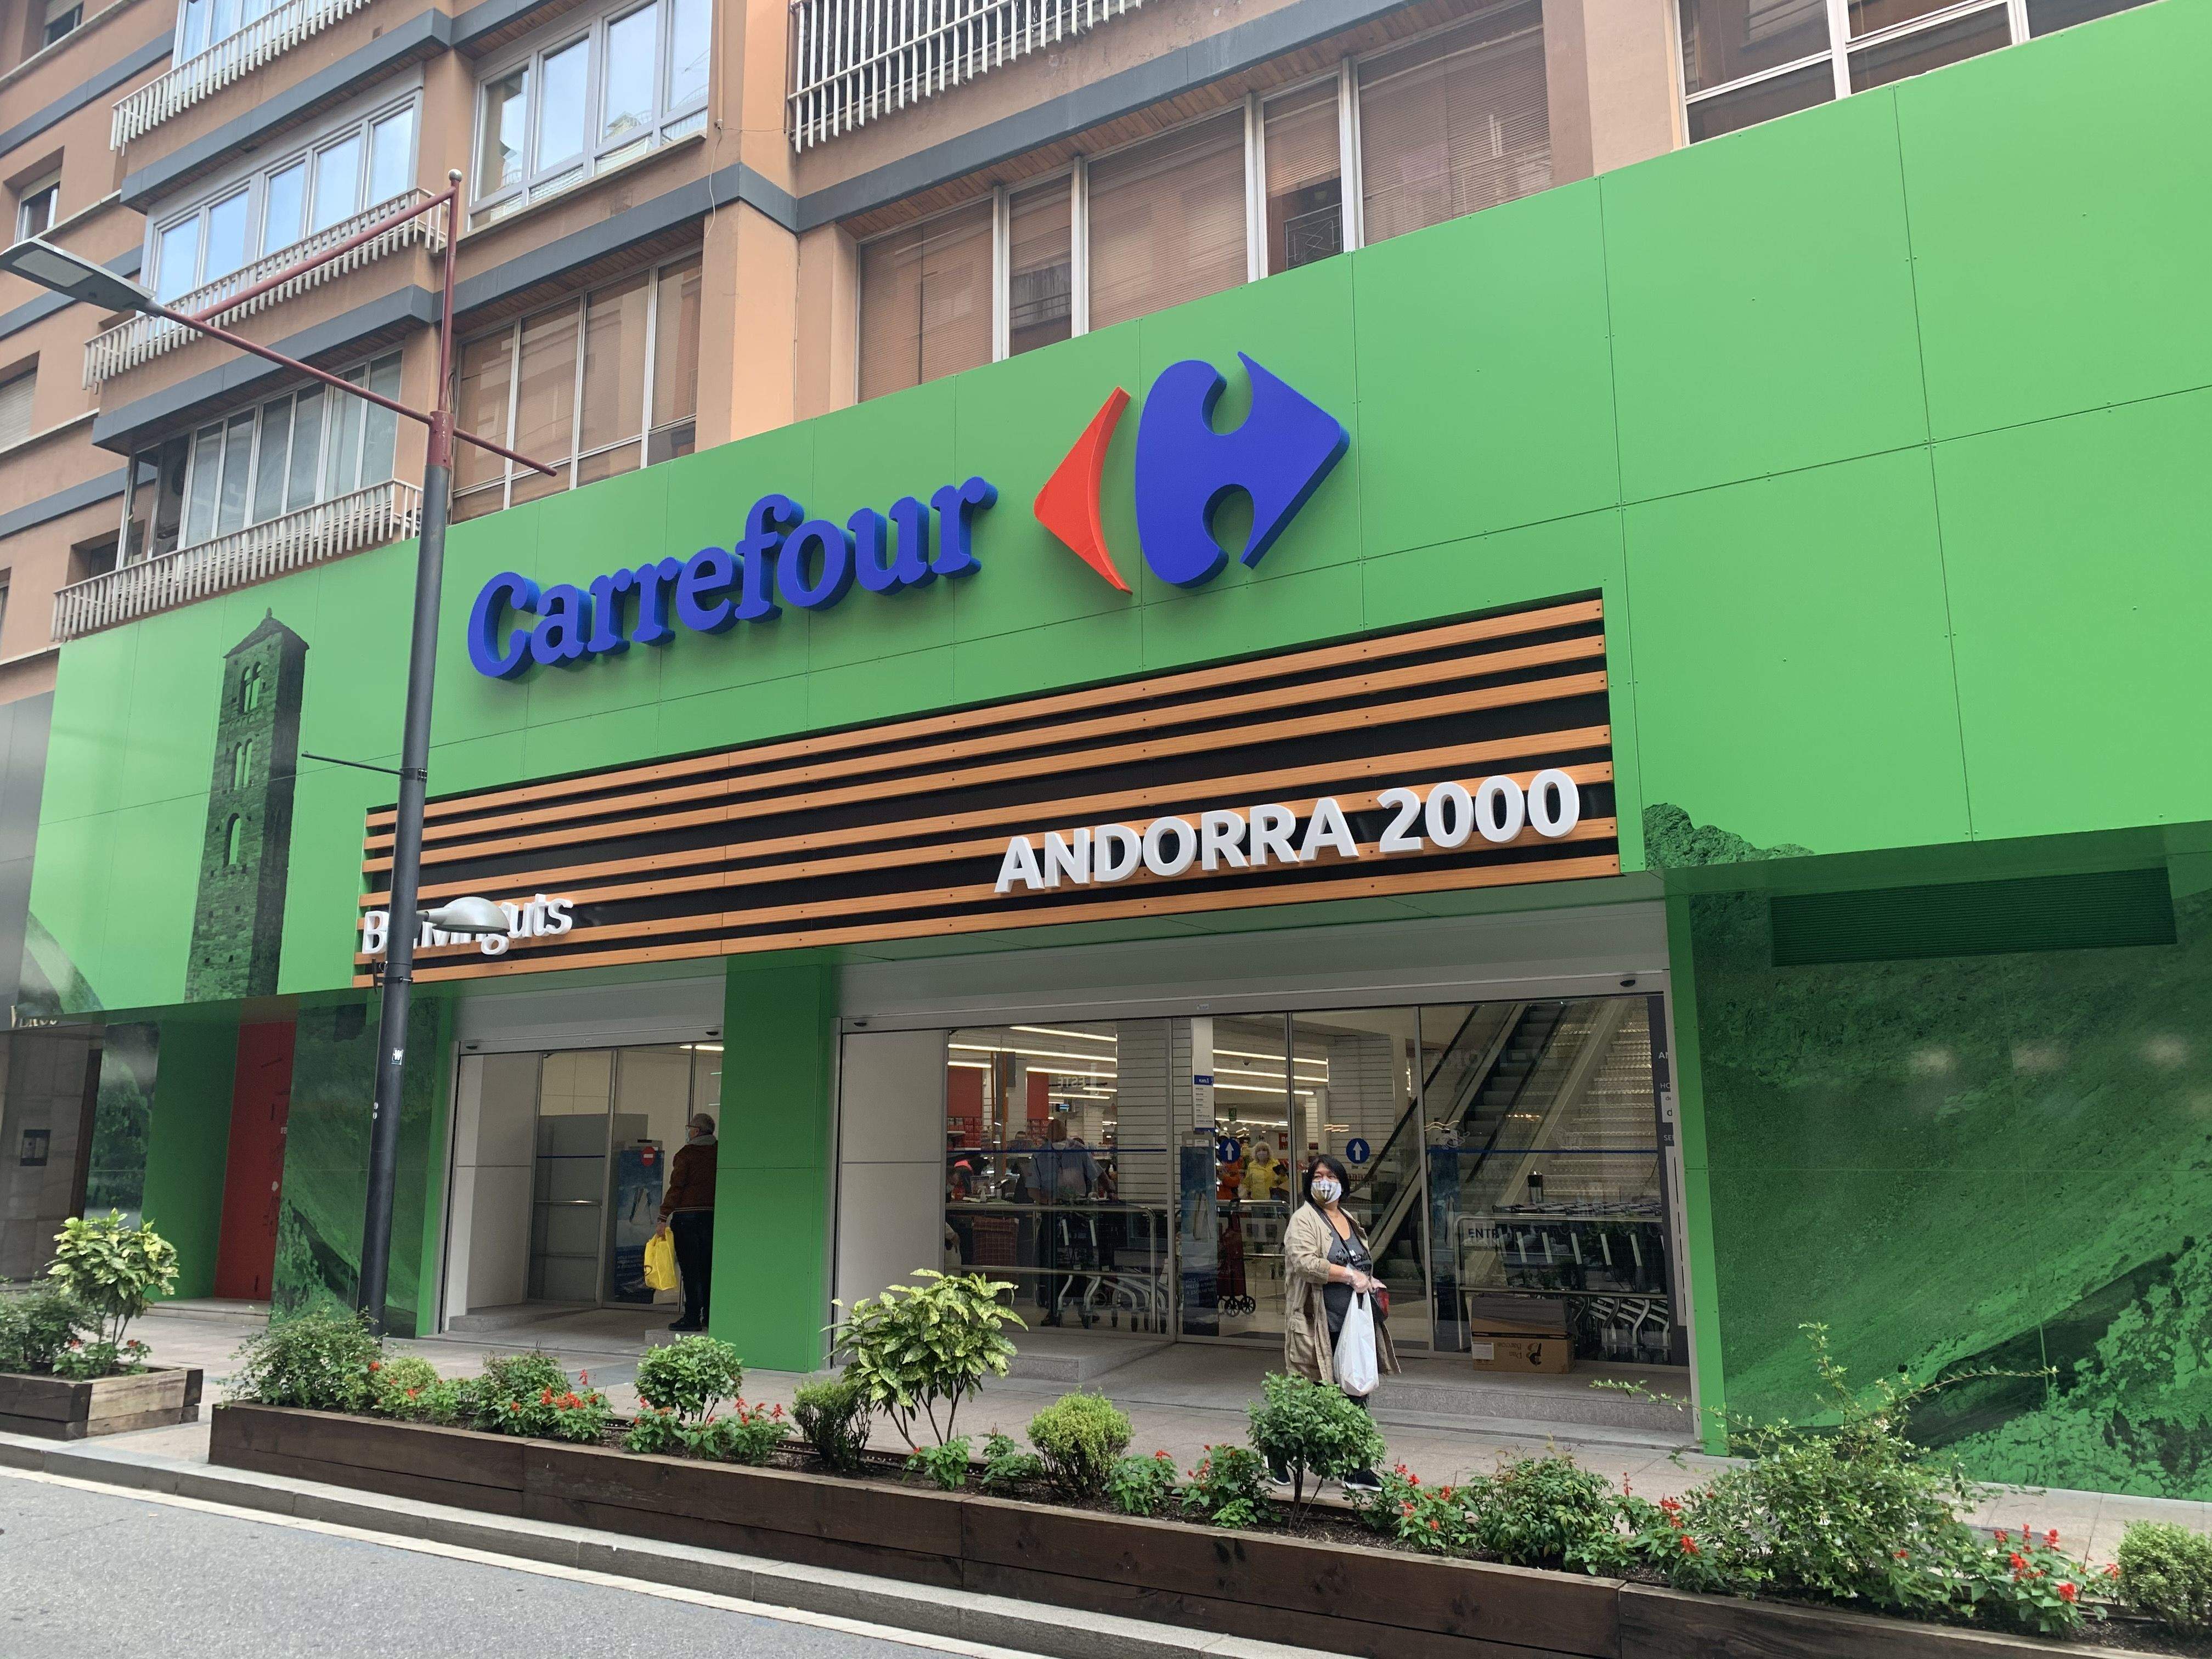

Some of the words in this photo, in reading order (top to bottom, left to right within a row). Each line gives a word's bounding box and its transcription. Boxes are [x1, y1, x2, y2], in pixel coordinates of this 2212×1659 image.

[467, 476, 998, 680] Carrefour
[994, 797, 1359, 893] ANDORRA
[1377, 768, 1580, 853] 2000
